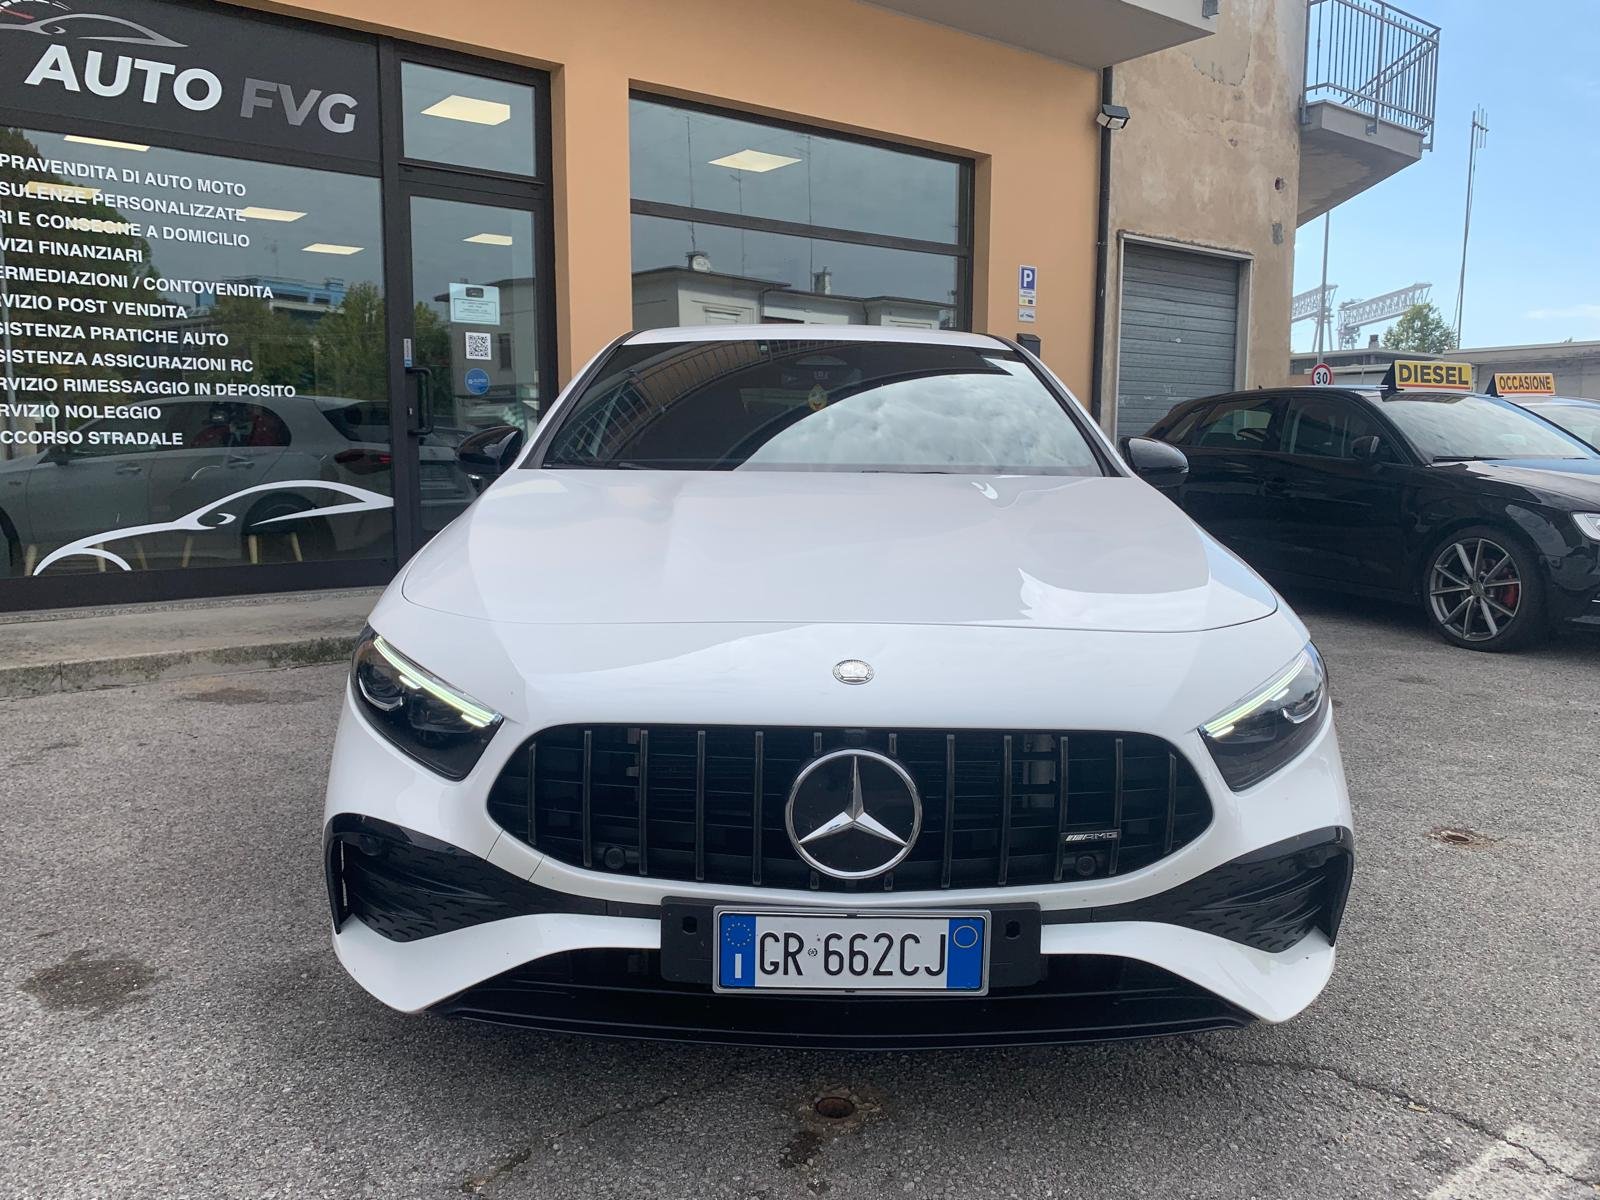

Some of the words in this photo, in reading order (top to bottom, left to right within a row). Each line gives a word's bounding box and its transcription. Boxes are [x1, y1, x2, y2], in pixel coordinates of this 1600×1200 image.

[24, 44, 223, 111] AUTO
[240, 77, 358, 134] FVG
[0, 153, 118, 181] PRAVENDITA
[122, 169, 140, 184] DI
[145, 172, 193, 191] AUTO
[197, 179, 247, 197] MOTO
[92, 190, 247, 223] PERSONALIZZATE
[18, 211, 31, 226] E
[146, 224, 159, 239] A
[163, 227, 250, 248] DOMICILIO
[39, 240, 143, 263] FINANZIARI
[143, 276, 274, 300] CONTOVENDITA
[1023, 269, 1033, 288] P
[0, 293, 52, 311] VIZIO
[58, 297, 109, 315] POST
[112, 302, 188, 320] VENDITA
[90, 326, 178, 345] PRATICHE
[182, 331, 229, 347] AUTO
[91, 352, 226, 372] ASSICURAZIONI
[230, 359, 254, 373] RC
[1315, 371, 1328, 386] 30
[1400, 363, 1469, 386] DIESEL
[1499, 375, 1552, 391] OCCASIONE
[63, 379, 189, 396] RIMESSAGGIO
[194, 382, 212, 396] IN
[215, 383, 297, 398] DEPOSITO
[65, 404, 162, 420] NOLEGGIO
[88, 430, 184, 446] STRADALE
